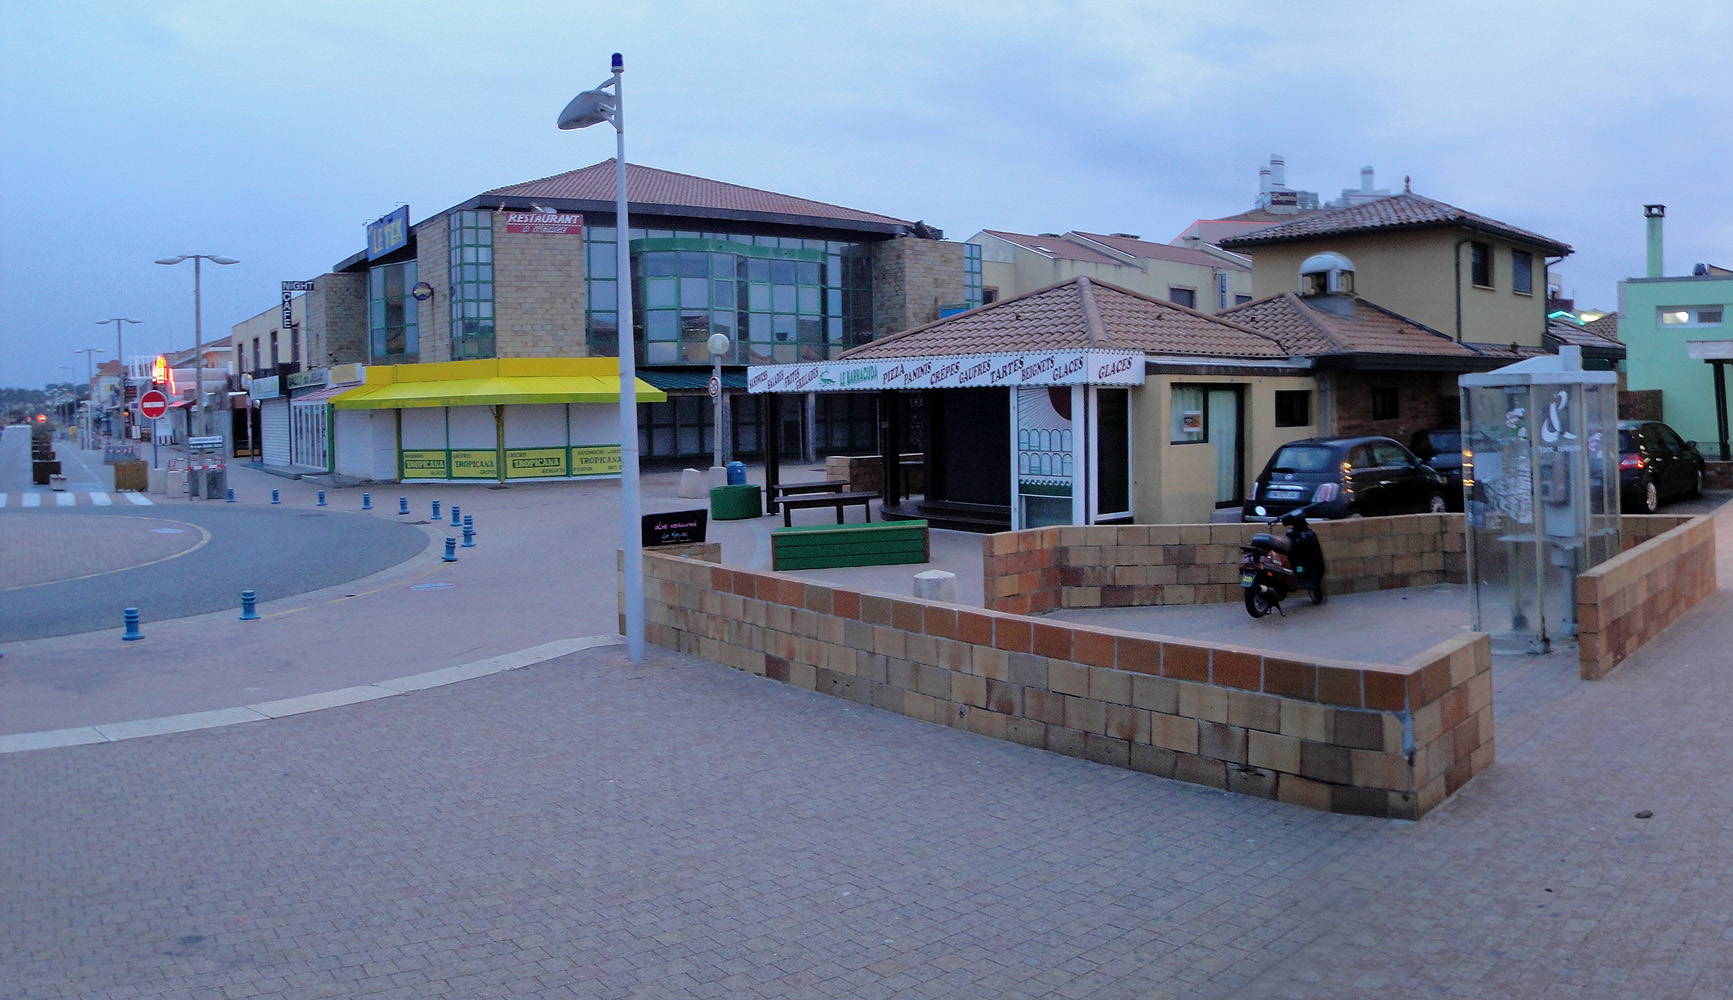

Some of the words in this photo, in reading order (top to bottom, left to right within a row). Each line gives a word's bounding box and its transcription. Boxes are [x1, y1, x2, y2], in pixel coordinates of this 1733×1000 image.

[507, 213, 580, 224] RESTAURANT
[372, 227, 384, 254] LE
[282, 281, 314, 290] NIGHT
[283, 292, 292, 328] CAFE
[846, 365, 878, 385] BARRACUDA
[882, 363, 905, 385] PIZZA
[904, 361, 932, 385] PANINIS
[959, 359, 991, 384] GAUFRES
[990, 356, 1025, 384] TARTES
[1021, 355, 1055, 382] BEIGNETS
[1052, 356, 1085, 381] GLACES
[1098, 356, 1133, 379] GLACES
[767, 370, 784, 390] SALADES
[785, 367, 800, 388] FRITES
[796, 366, 819, 391] GRILLADES
[406, 460, 444, 469] TROPICANA
[454, 460, 494, 468] TROPICANA
[513, 458, 559, 468] TROPICANA
[580, 456, 621, 464] TROPICANA
